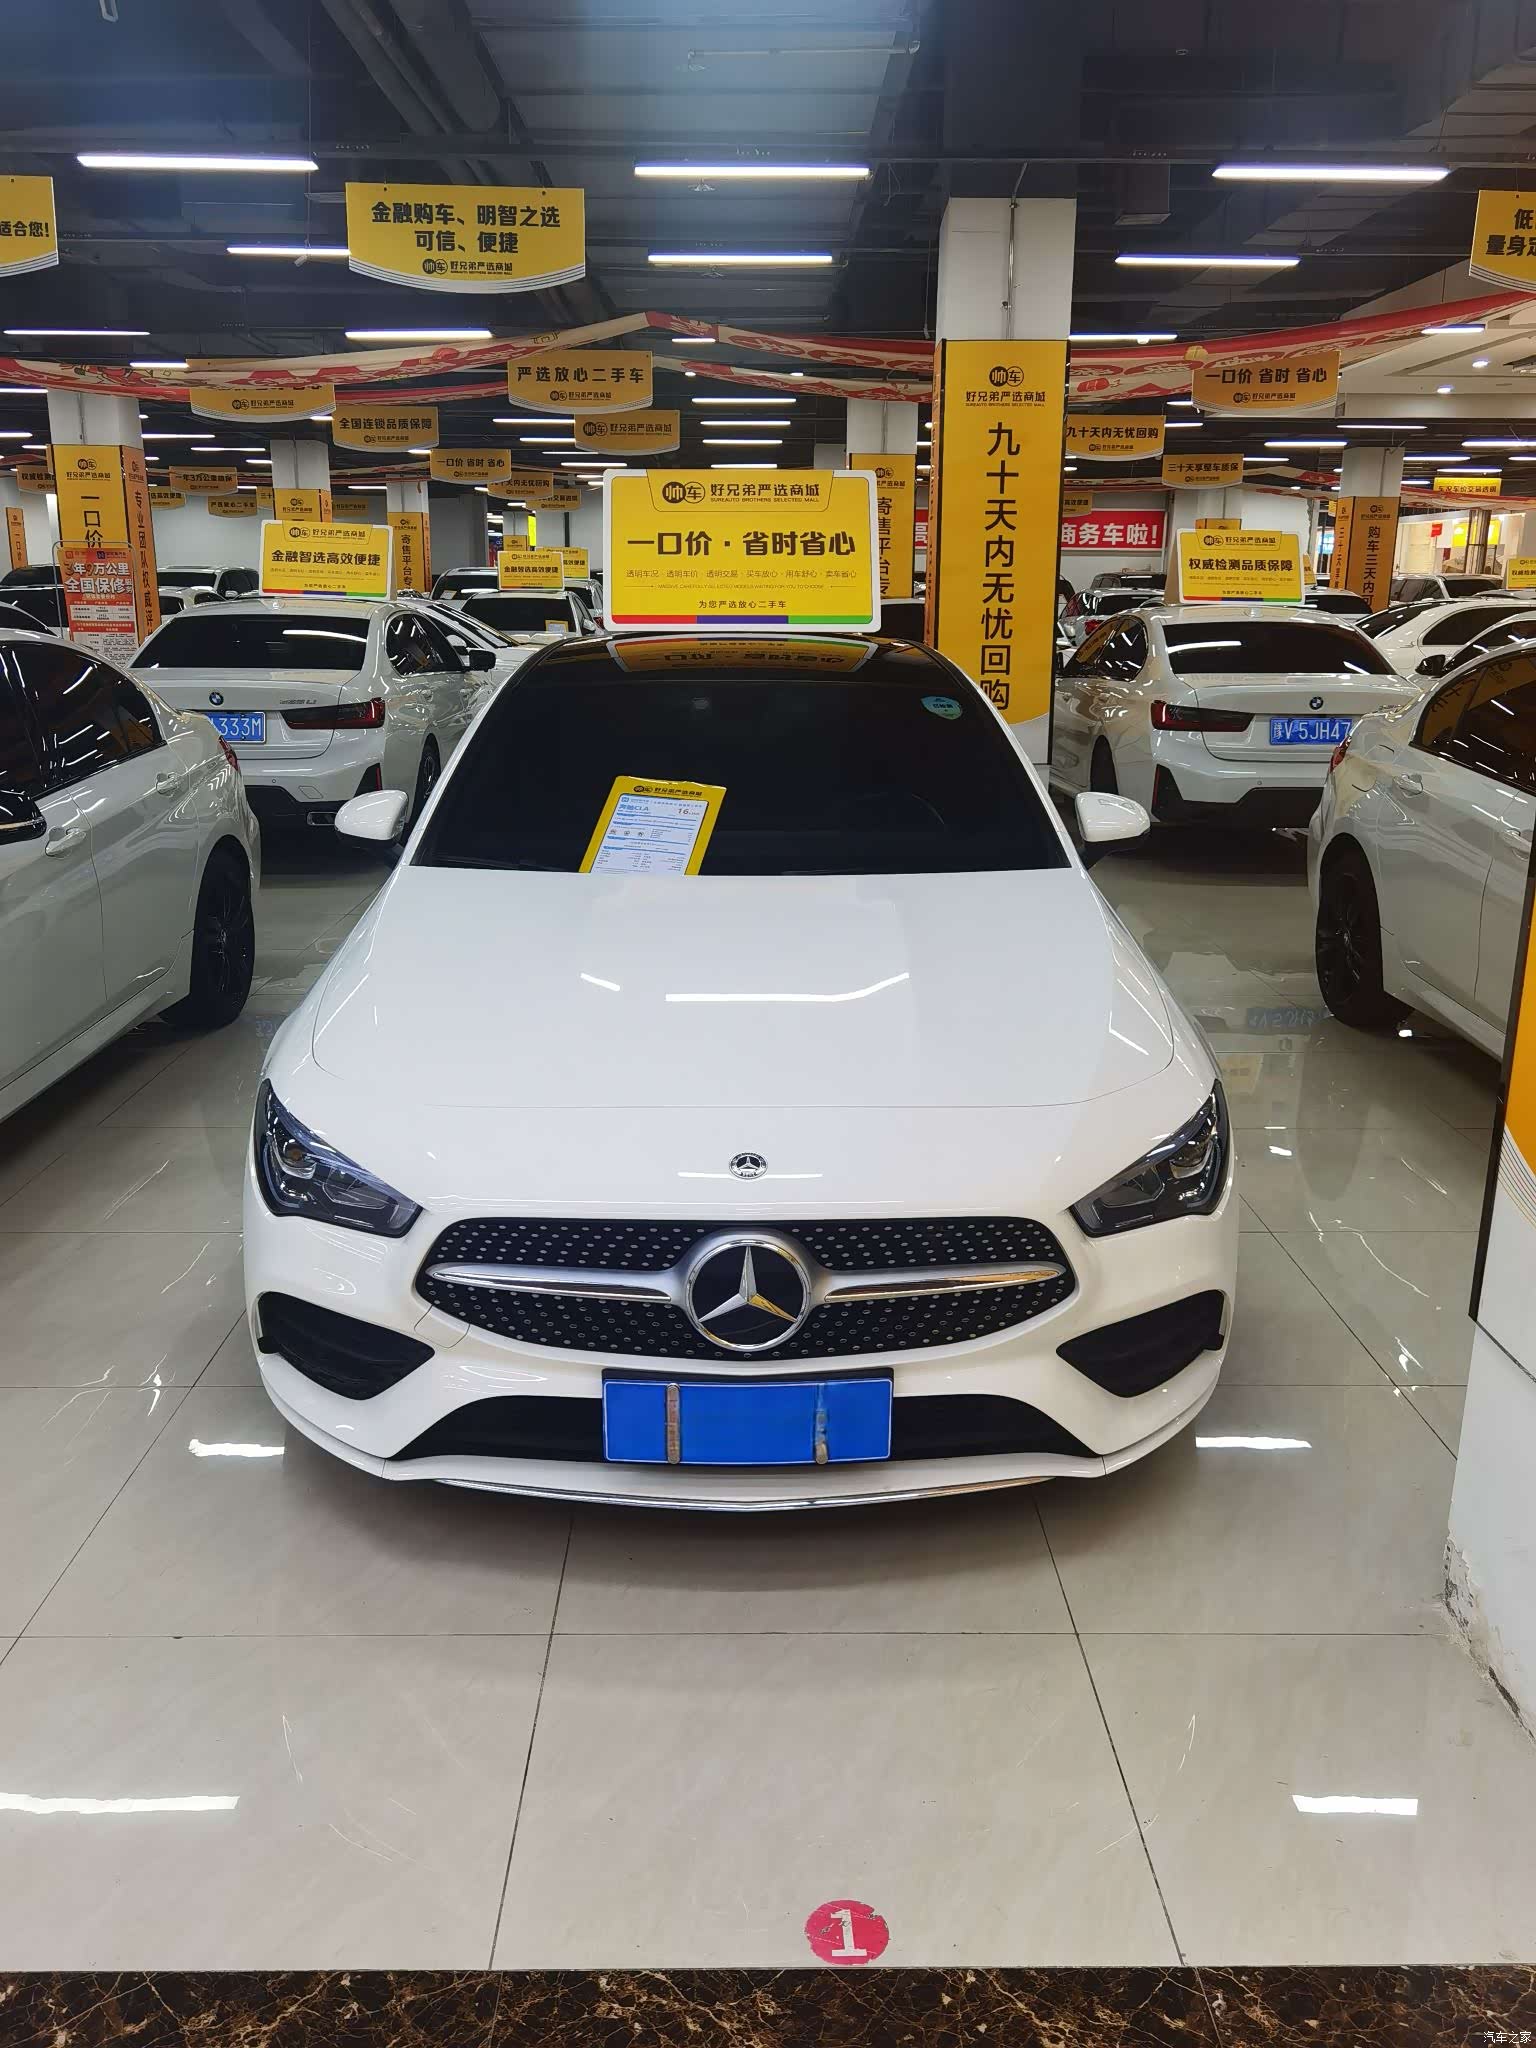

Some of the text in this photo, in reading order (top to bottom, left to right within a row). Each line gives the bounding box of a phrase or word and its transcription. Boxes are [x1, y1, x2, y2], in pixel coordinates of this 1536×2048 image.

[371, 201, 560, 228] 金融购车、明智之选
[1514, 208, 1536, 230] 低
[414, 230, 519, 254] 可信、便捷
[517, 366, 644, 384] 严选放心二手车
[1205, 368, 1327, 385] 一口价 省时 省心
[966, 391, 1046, 402] 好兄弟严选商城
[339, 418, 433, 430] 全国连锁品质保障
[1067, 427, 1159, 439] 九十天内无忧回购
[710, 484, 820, 497] 好兄弟严选商城
[271, 549, 381, 566] 金融智选高效便捷
[401, 533, 413, 589] 寄售平台专
[1188, 558, 1293, 572] 权威检测品质保障
[978, 422, 1020, 712] 九十天内无忧回购
[698, 600, 787, 609] 为您严选放心二手车
[210, 717, 262, 736] 333M
[831, 1909, 867, 1957] 1
